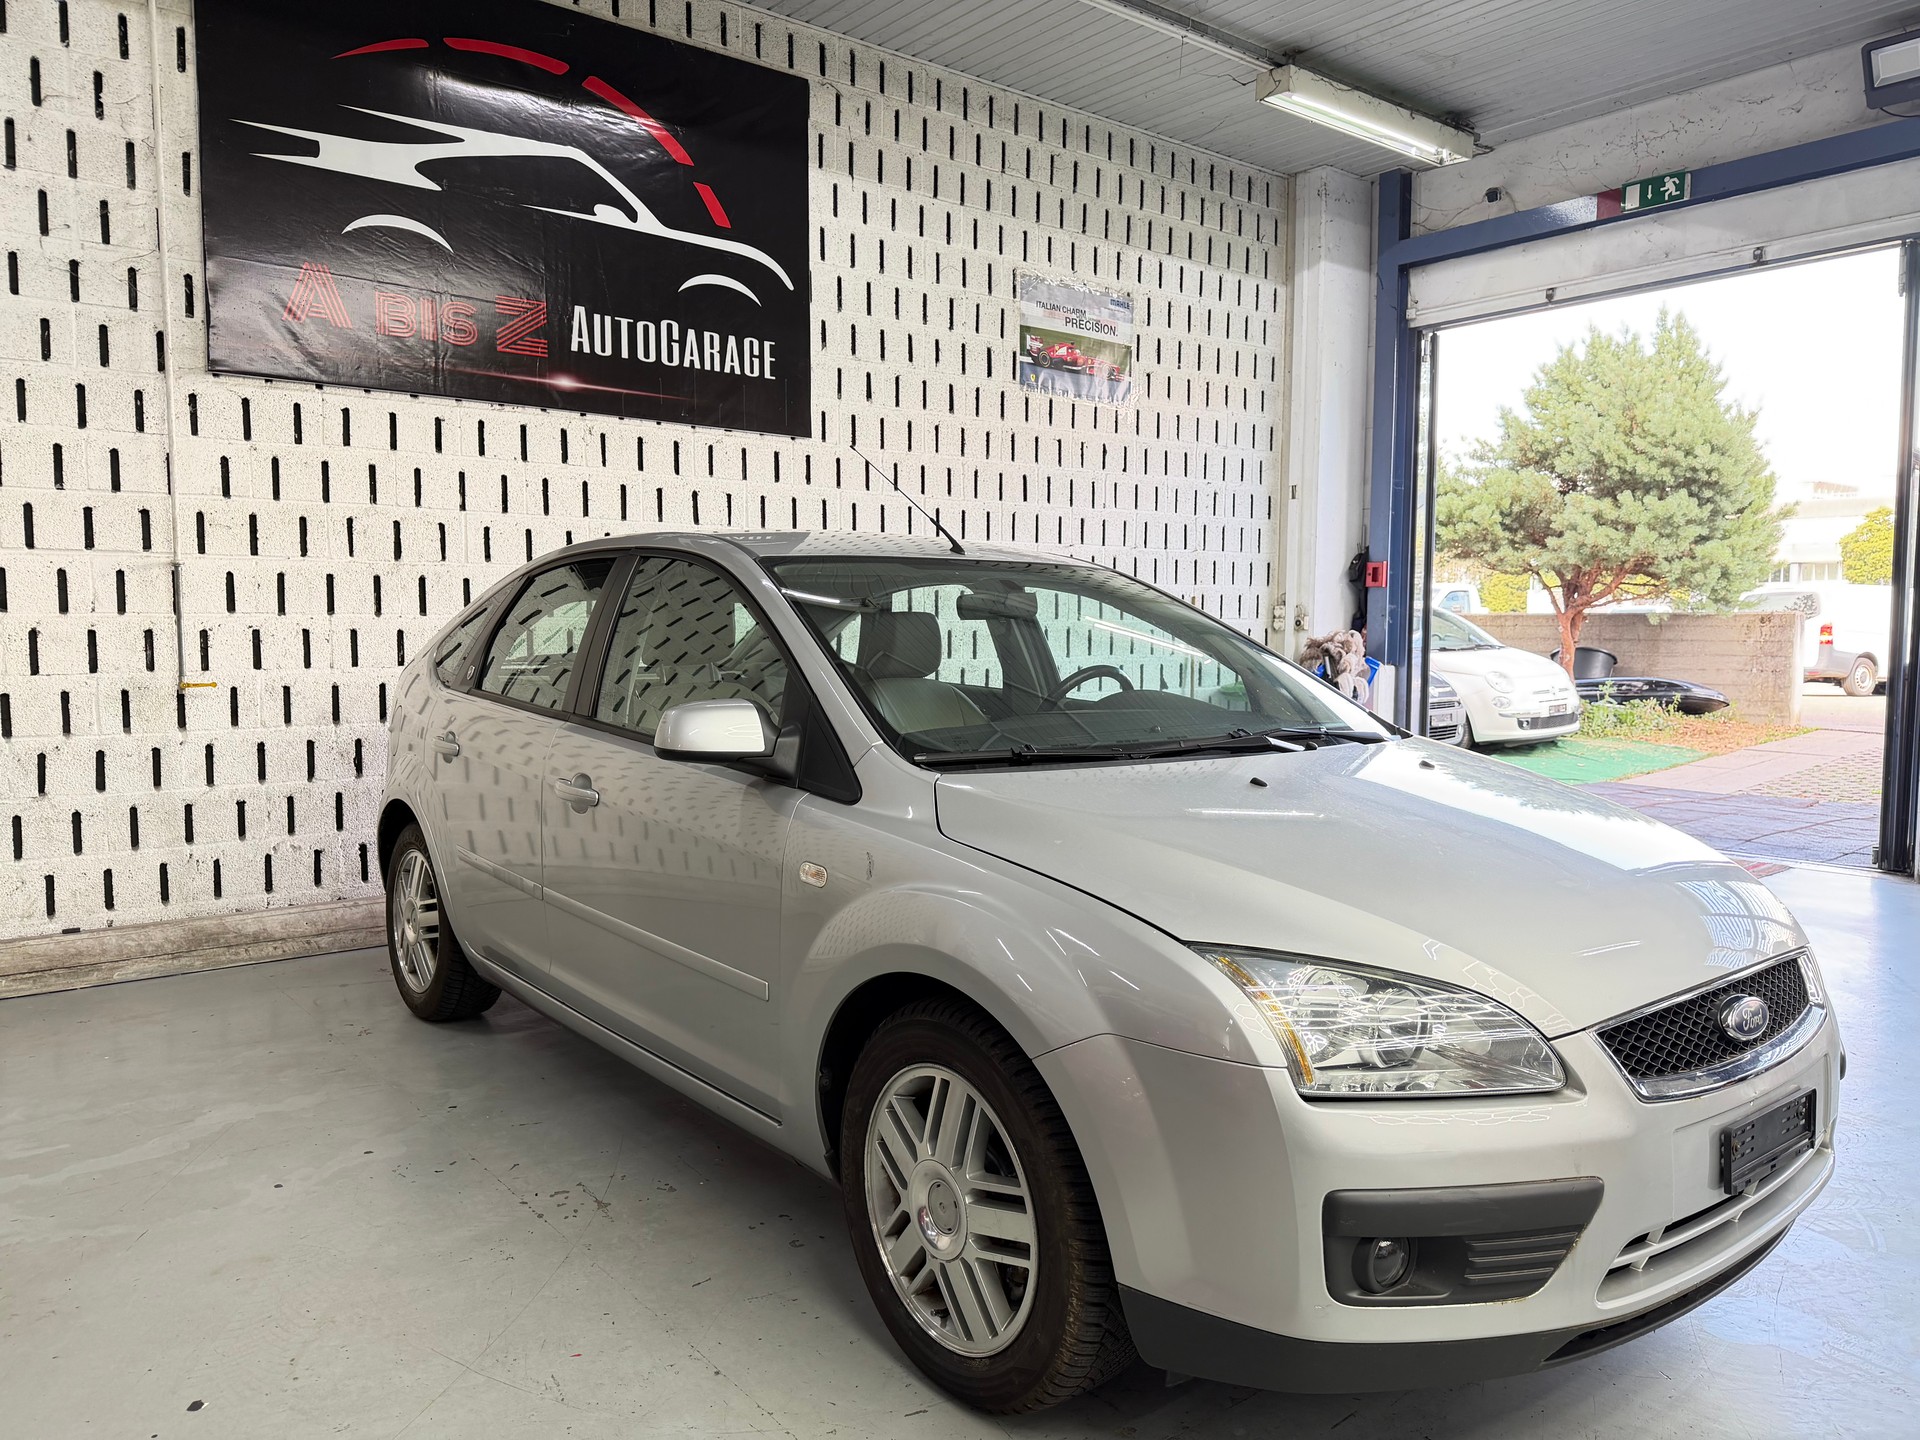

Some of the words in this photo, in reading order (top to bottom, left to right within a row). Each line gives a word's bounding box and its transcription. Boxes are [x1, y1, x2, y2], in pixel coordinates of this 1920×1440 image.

[282, 262, 352, 328] A
[495, 295, 548, 357] Z
[1035, 300, 1061, 312] ITALIAN
[1065, 316, 1119, 337] PRECISION.
[1742, 1007, 1762, 1030] Ford
